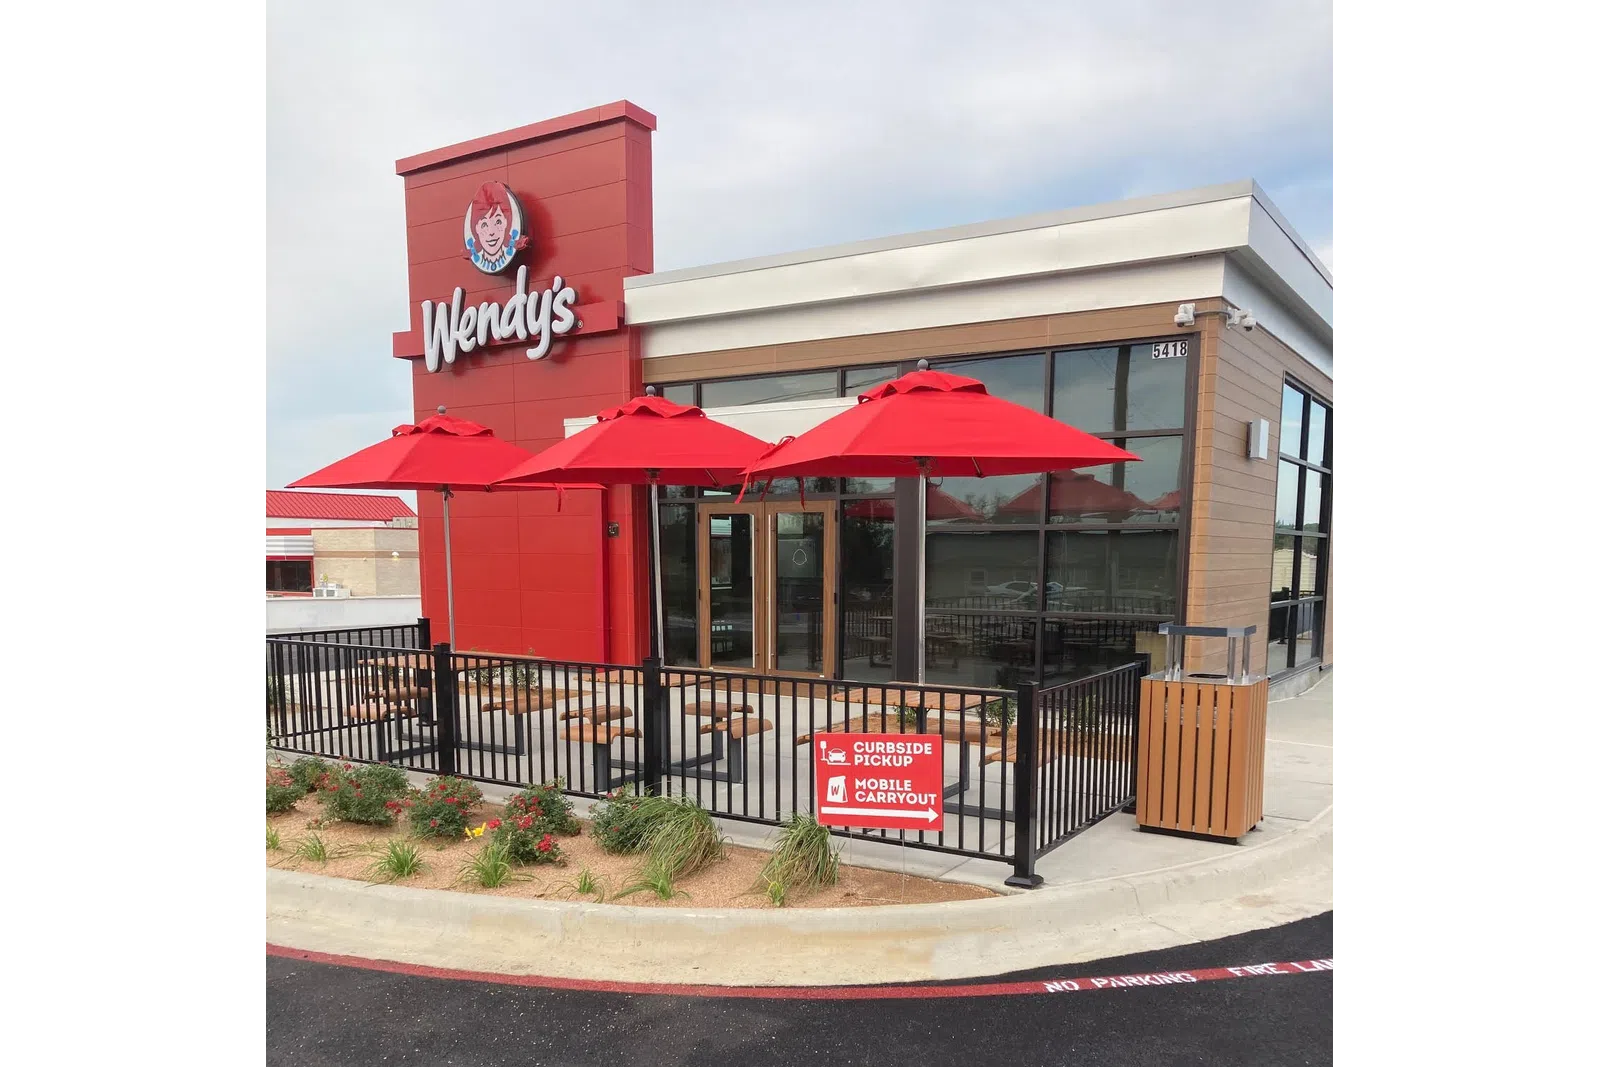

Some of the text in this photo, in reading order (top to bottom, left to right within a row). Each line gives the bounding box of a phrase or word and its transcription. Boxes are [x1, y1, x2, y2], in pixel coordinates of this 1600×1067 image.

[421, 265, 576, 373] Wendy's
[1153, 341, 1187, 358] 5418
[853, 741, 932, 754] CURBSIDE
[854, 755, 913, 767] PICKUP
[831, 784, 840, 797] W
[855, 778, 912, 791] MOBILE
[855, 791, 937, 806] CARRYOUT
[1043, 980, 1080, 993] NO
[1090, 972, 1197, 988] PARKING
[1226, 963, 1289, 977] FIRE
